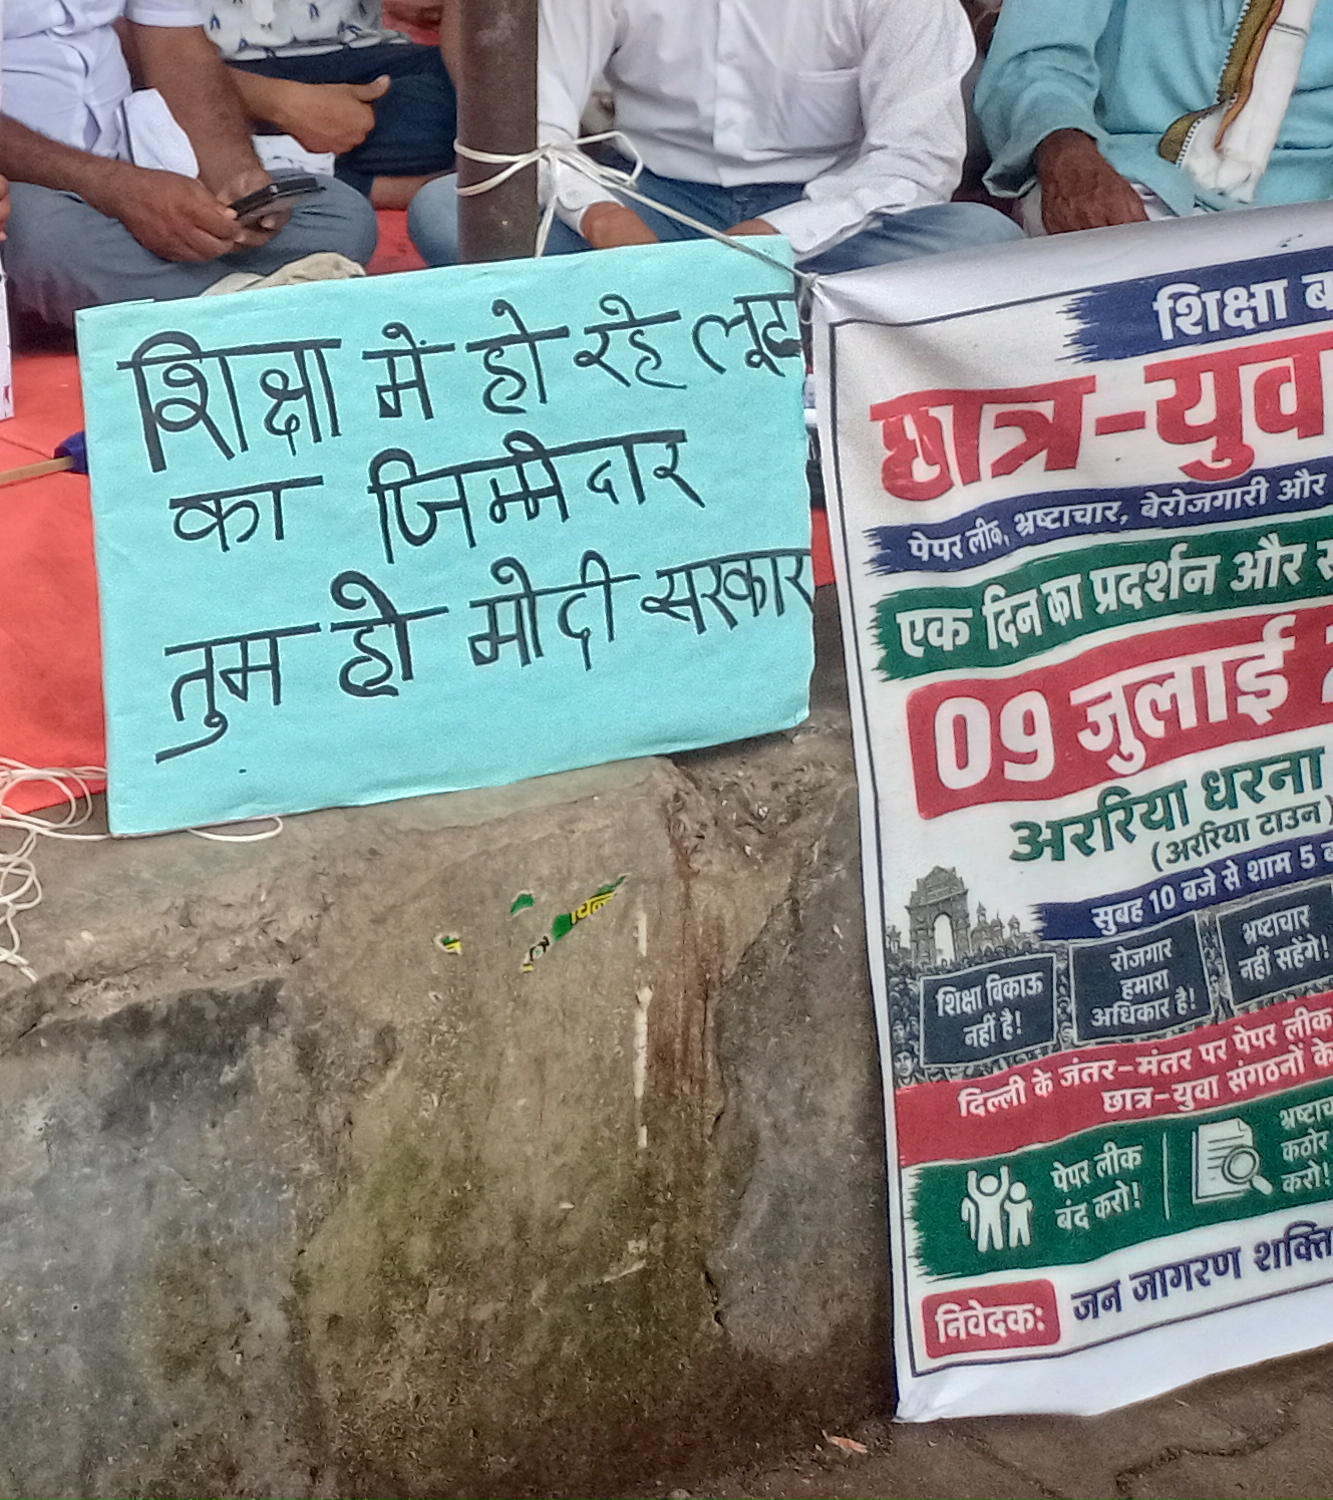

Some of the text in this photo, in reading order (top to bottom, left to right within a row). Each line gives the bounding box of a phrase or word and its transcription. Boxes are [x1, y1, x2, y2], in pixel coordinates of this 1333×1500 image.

[1152, 278, 1289, 342] शिक्षा
[117, 330, 342, 472] शिक्षा
[362, 323, 455, 420] में
[466, 299, 569, 414] हो
[574, 294, 687, 389] रहे
[169, 429, 706, 565] का जिम्मेदार
[908, 531, 964, 562] पेपर
[1014, 501, 1129, 538] भ्रष्टाचार,
[1140, 476, 1270, 519] बेरोजगारी
[1276, 468, 1328, 501] और
[896, 607, 974, 658] एक
[982, 584, 1043, 650] दिन
[1040, 574, 1083, 627] का
[1089, 542, 1222, 614] प्रदर्शन
[1229, 532, 1308, 592] और
[154, 547, 816, 764] तुम हो मोदी सरकार
[934, 689, 1057, 791] 09
[1069, 613, 1297, 776] जुलाई
[1009, 746, 1326, 862] अररिया धरना
[1091, 897, 1145, 936] सुबह
[1149, 885, 1176, 915] 10
[1180, 868, 1217, 902] बजे
[1221, 860, 1242, 891] से
[1247, 851, 1293, 883] शाम
[1299, 843, 1316, 870] 5
[1109, 937, 1174, 972] रोजगार
[1241, 904, 1311, 945] भ्रष्टाचार
[1119, 969, 1170, 1001] हमारा
[1238, 945, 1272, 981] नहीं
[935, 985, 983, 1017] शिक्षा
[963, 1007, 1023, 1048] नहीं है!
[1091, 985, 1196, 1028] अधिकार है!
[957, 1006, 1333, 1118] दिल्ली के जंतर-मंतर पर पेपर लीक
[1101, 1075, 1221, 1113] छात्र-युवा
[1225, 1041, 1306, 1094] संगठनों
[1051, 1141, 1144, 1192] पेपर लीक
[1280, 1128, 1330, 1162] कठोर
[1281, 1160, 1332, 1194] करो!
[1054, 1181, 1143, 1231] बंद करो!
[1070, 1279, 1123, 1322] जन
[1129, 1246, 1242, 1303] जागरण
[1253, 1219, 1333, 1273] शक्ति
